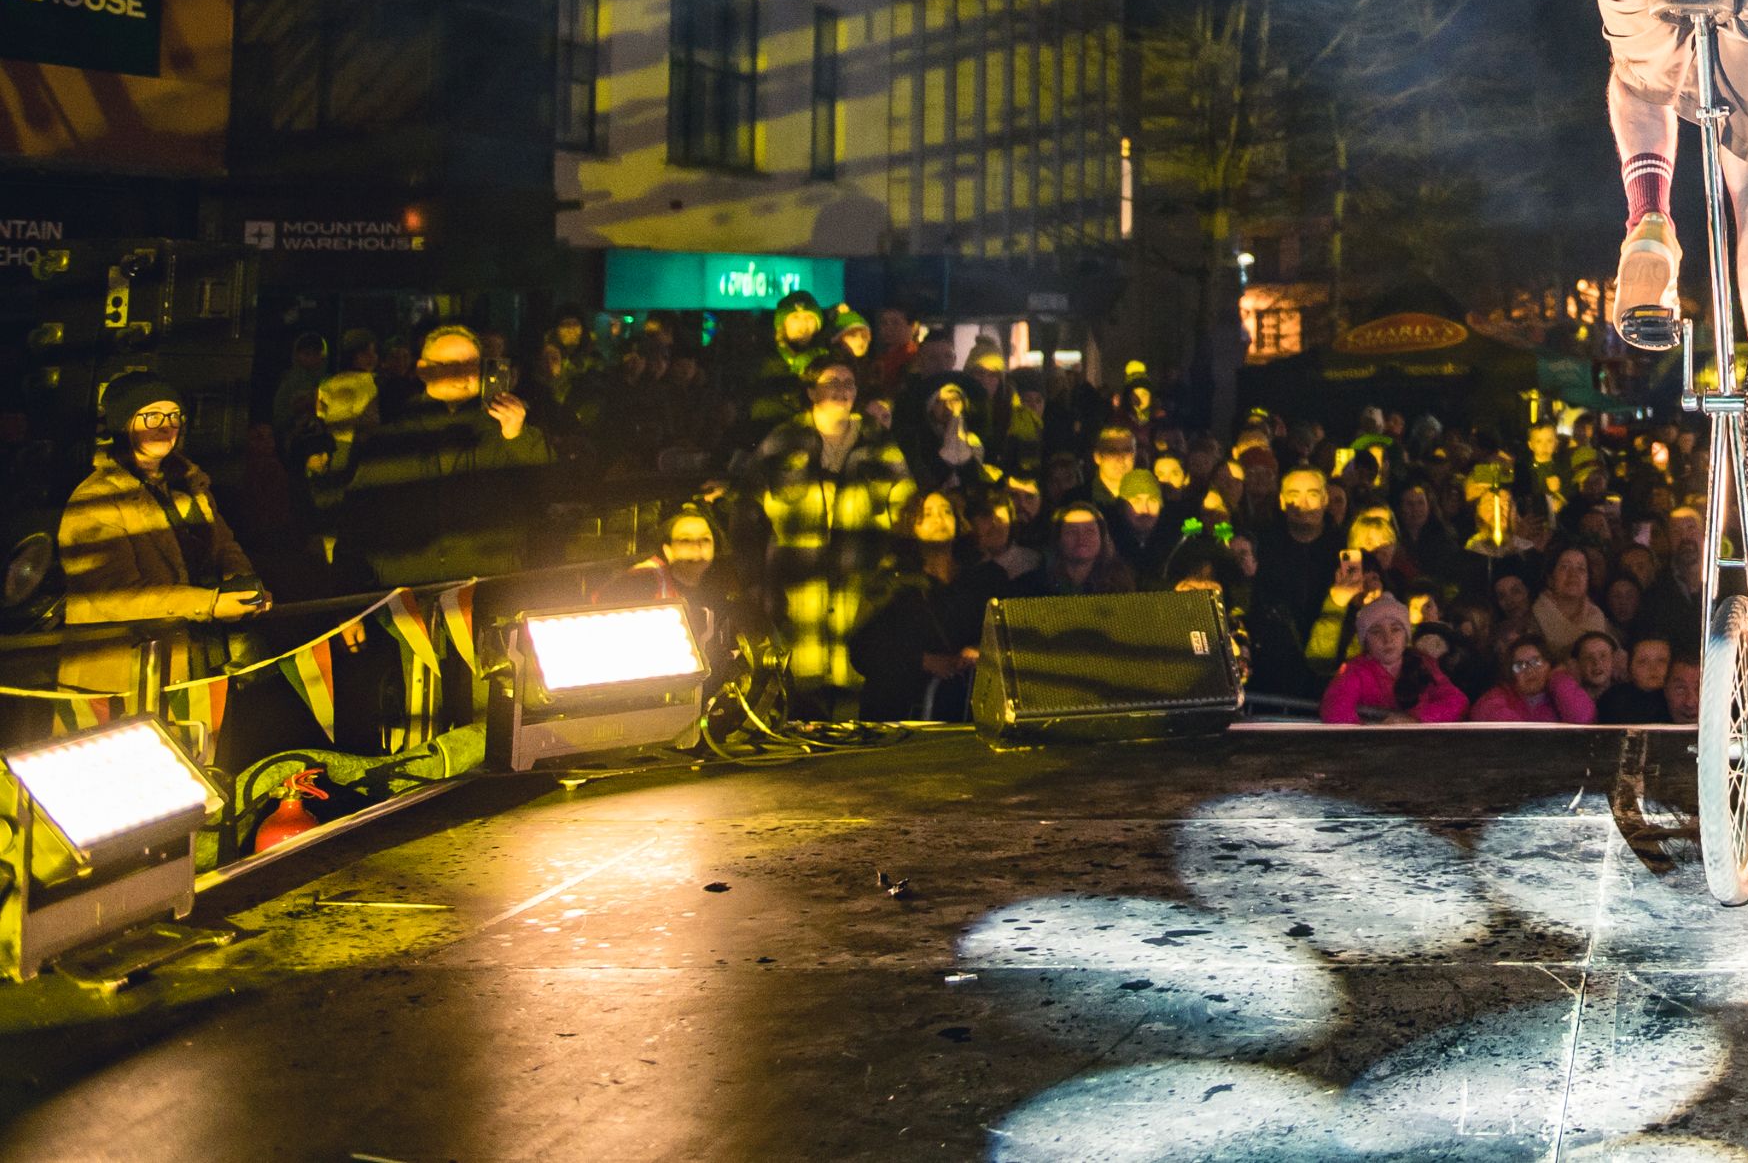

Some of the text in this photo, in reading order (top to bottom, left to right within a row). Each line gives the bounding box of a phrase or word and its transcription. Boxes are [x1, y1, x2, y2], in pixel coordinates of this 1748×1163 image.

[0, 218, 64, 240] NTAIN
[282, 220, 402, 235] MOUNTAIN
[281, 236, 425, 251] WAREHOUSE
